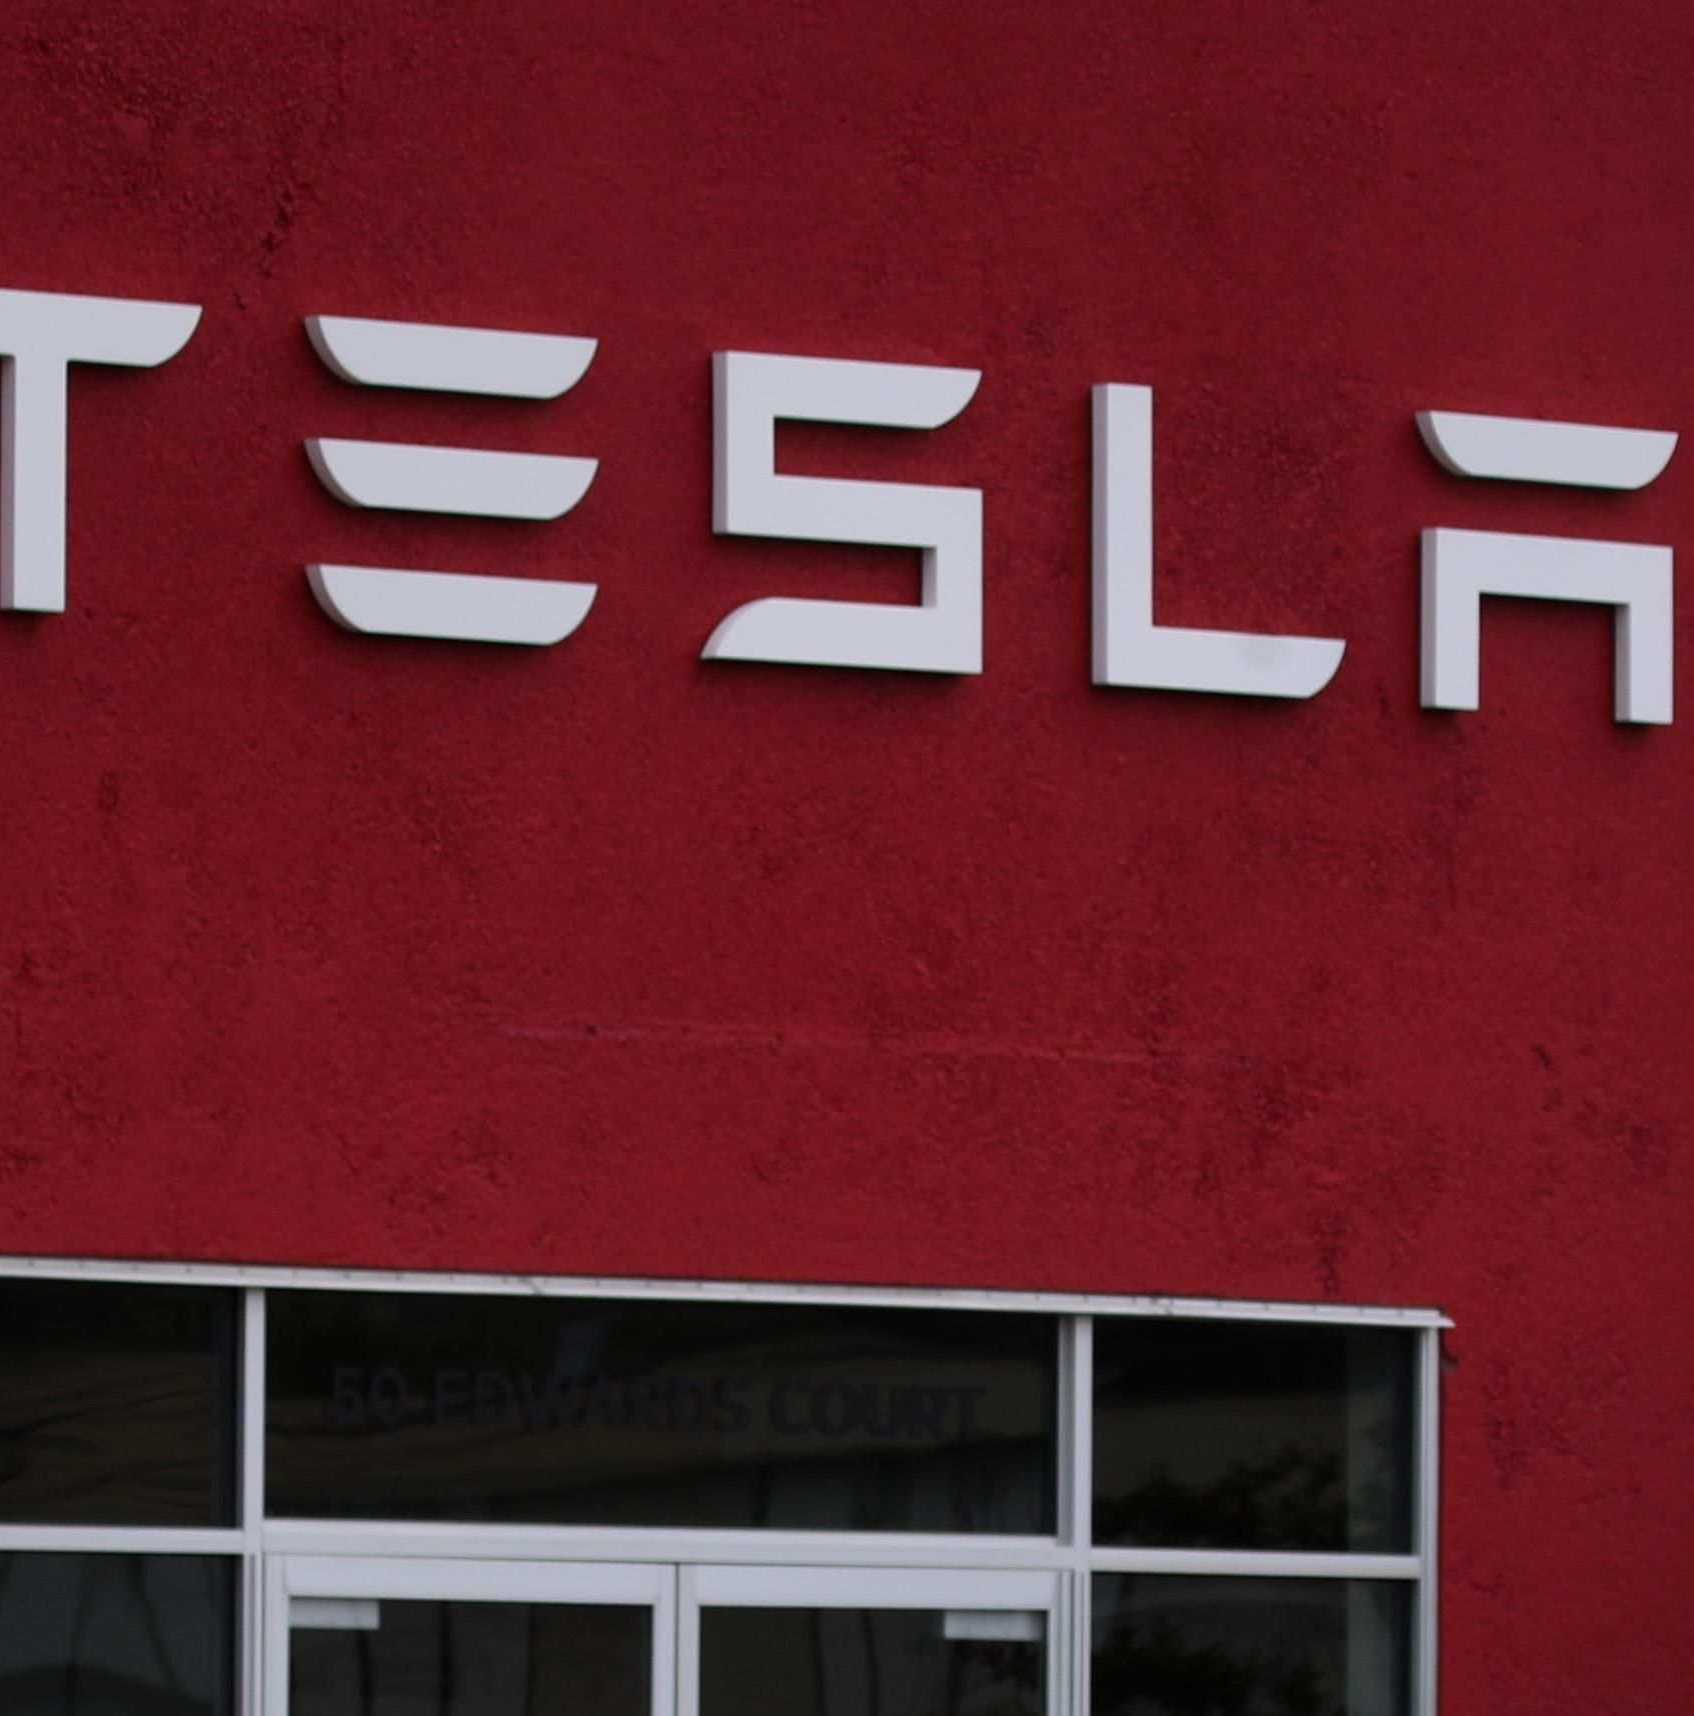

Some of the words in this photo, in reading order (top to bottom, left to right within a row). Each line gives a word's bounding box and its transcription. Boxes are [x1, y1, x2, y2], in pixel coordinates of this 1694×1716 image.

[331, 1366, 410, 1427] 50
[433, 1368, 755, 1433] EDWARDS
[764, 1379, 988, 1441] COURT
